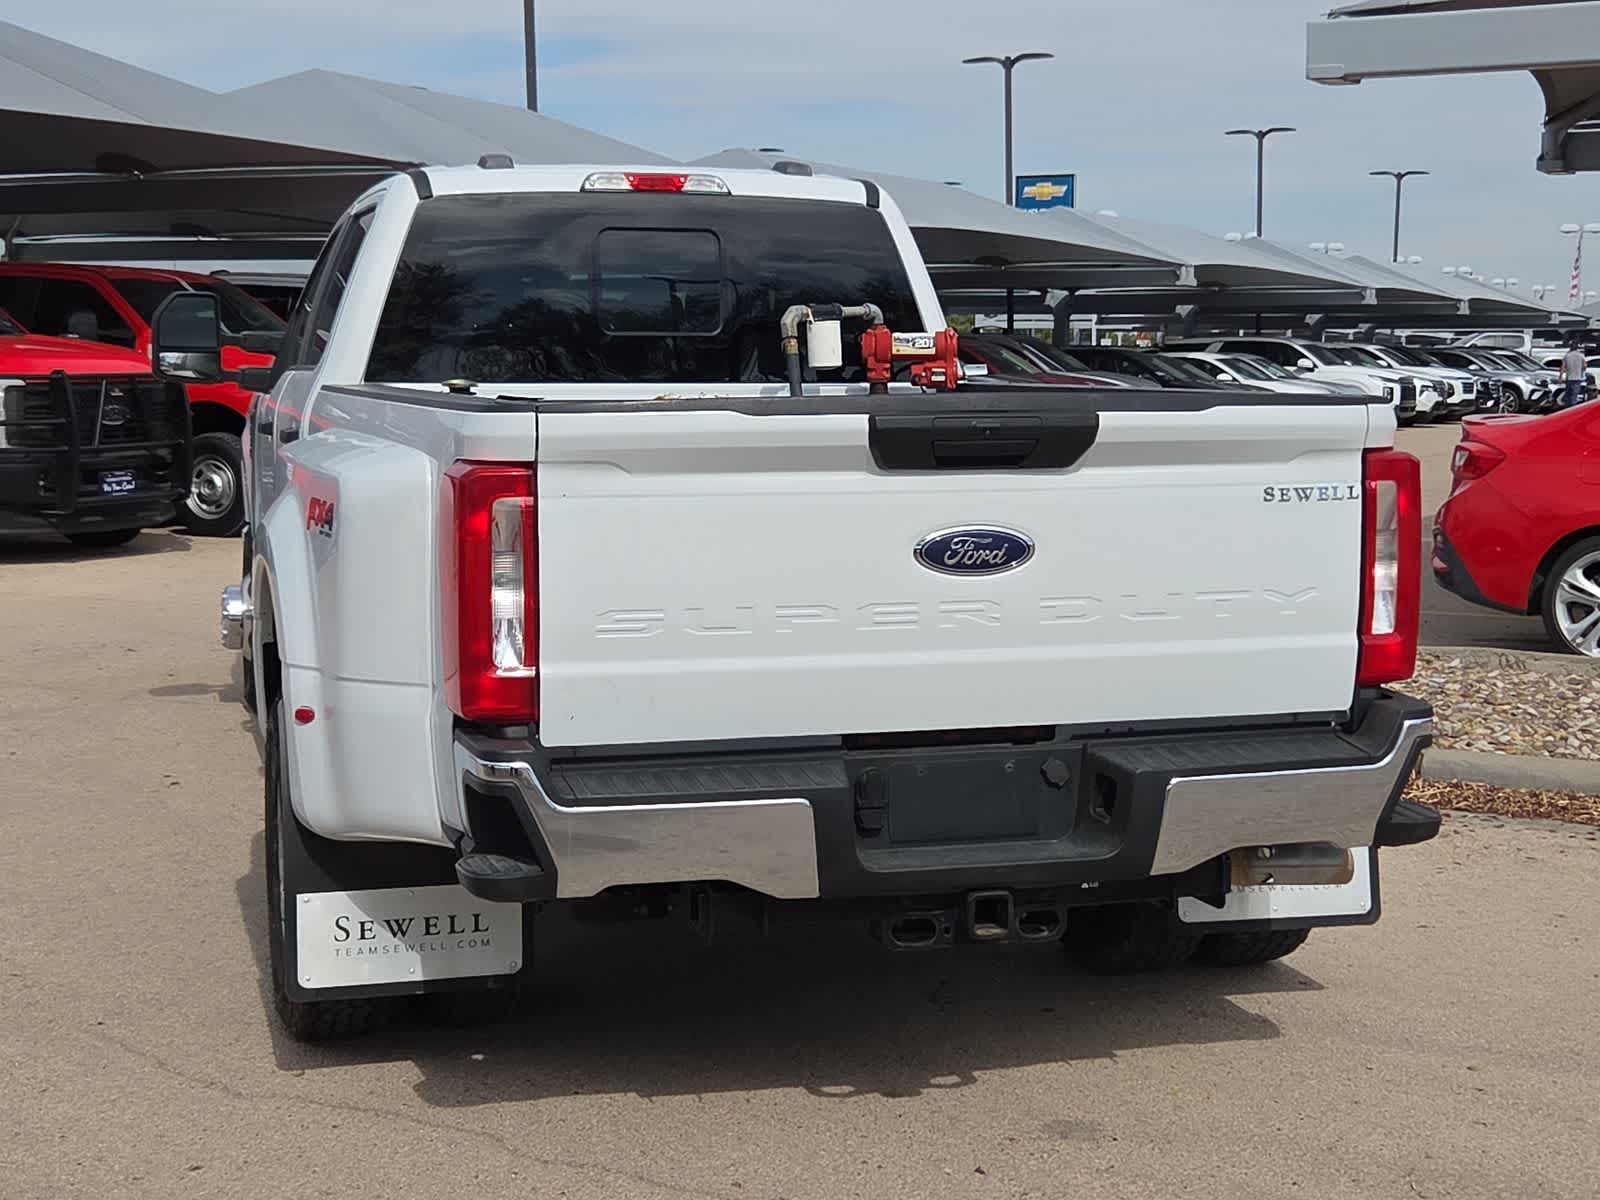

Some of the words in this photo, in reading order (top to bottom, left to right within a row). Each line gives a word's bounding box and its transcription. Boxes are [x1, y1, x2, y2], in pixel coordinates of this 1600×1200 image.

[1263, 485, 1360, 503] SEWELL
[943, 536, 1008, 566] Ford
[595, 600, 1002, 638] SUPER
[1039, 586, 1319, 624] DUTY
[333, 913, 490, 943] SEWELL
[335, 938, 491, 957] TEAMSEWELL.COM
